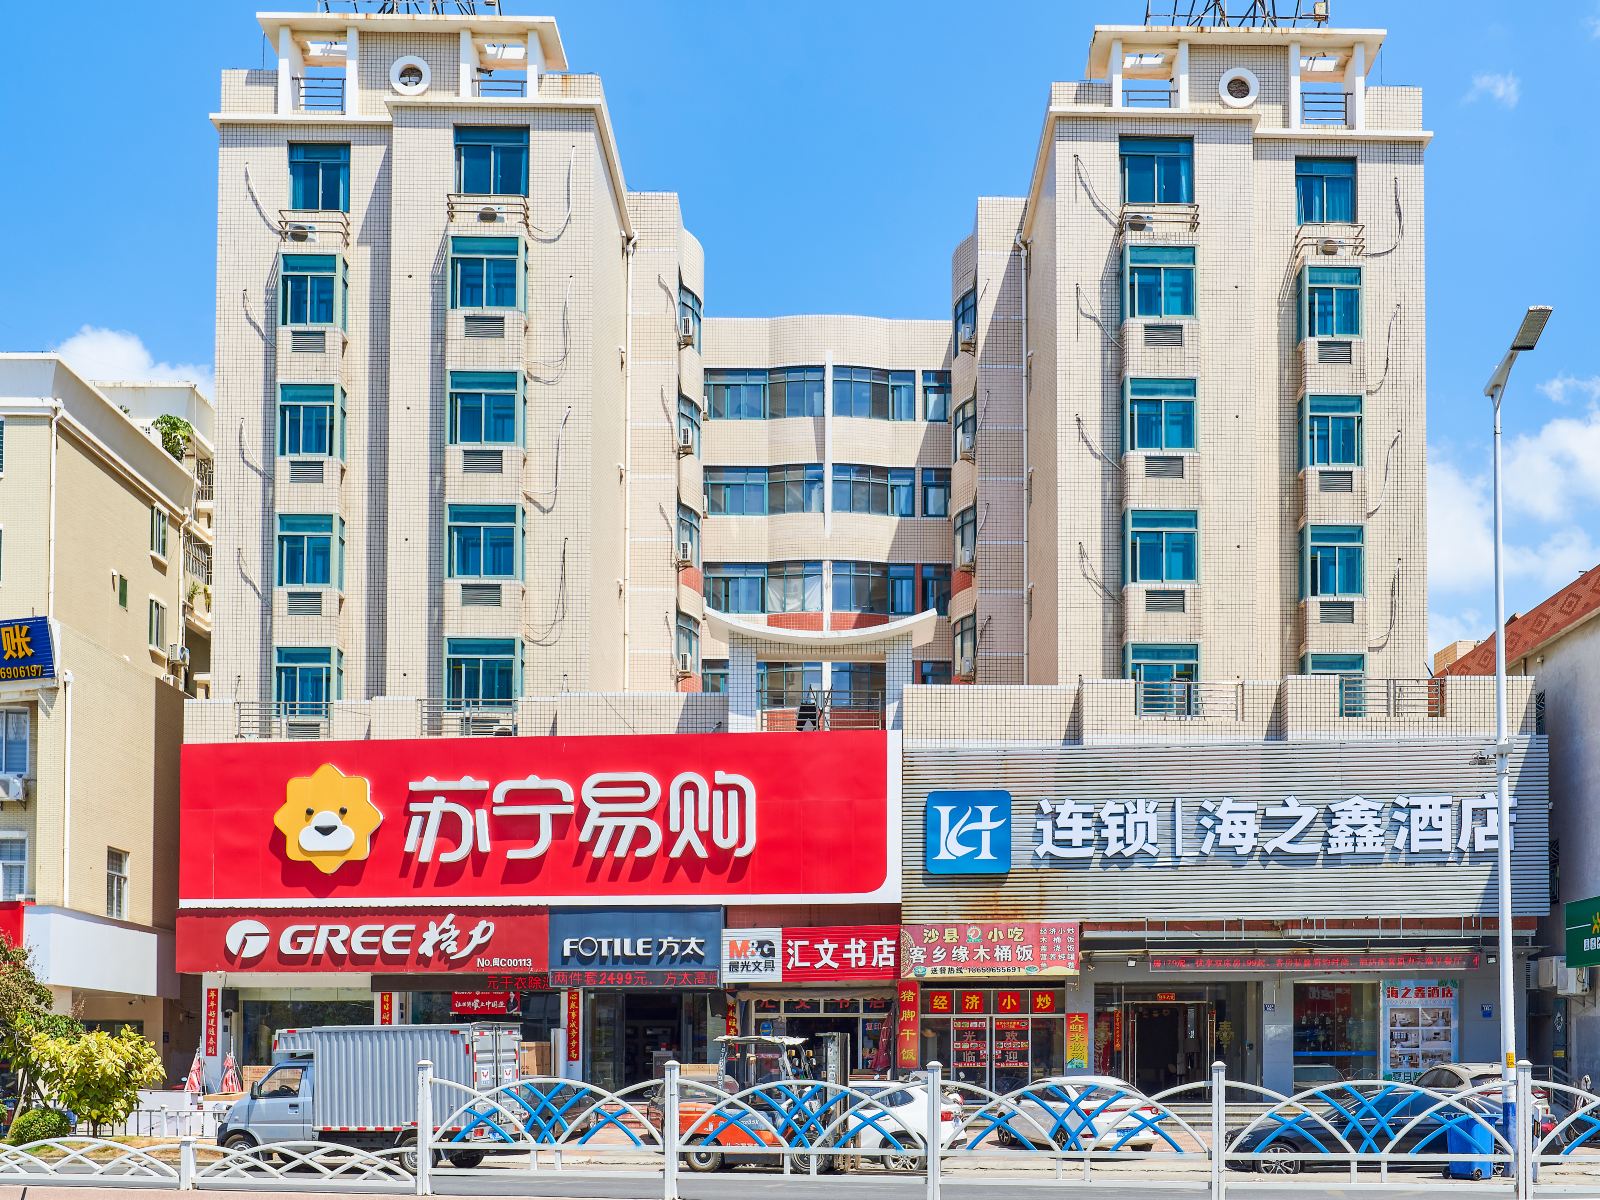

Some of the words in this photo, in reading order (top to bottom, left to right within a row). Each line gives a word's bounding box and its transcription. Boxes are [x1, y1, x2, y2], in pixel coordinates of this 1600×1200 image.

[1, 625, 34, 660] 账
[0, 665, 43, 679] 6906197
[404, 770, 757, 863] 苏宁易购
[1034, 797, 1160, 859] 连锁
[1199, 792, 1518, 856] 海之鑫酒店
[278, 924, 416, 955] GREE
[417, 913, 495, 960] 格力
[922, 927, 960, 944] 沙县
[987, 926, 1025, 943] 小吃
[563, 936, 653, 957] FOTILE
[658, 936, 706, 957] 方太
[728, 939, 776, 959] M&G
[786, 936, 896, 970] 汇文书店
[909, 944, 1034, 964] 客乡缘木桶饭
[728, 961, 776, 973] 晨光文具
[932, 995, 1053, 1010] 经济小炒
[1386, 985, 1454, 999] 海之鑫酒店
[900, 989, 916, 1061] 猪脚干饭
